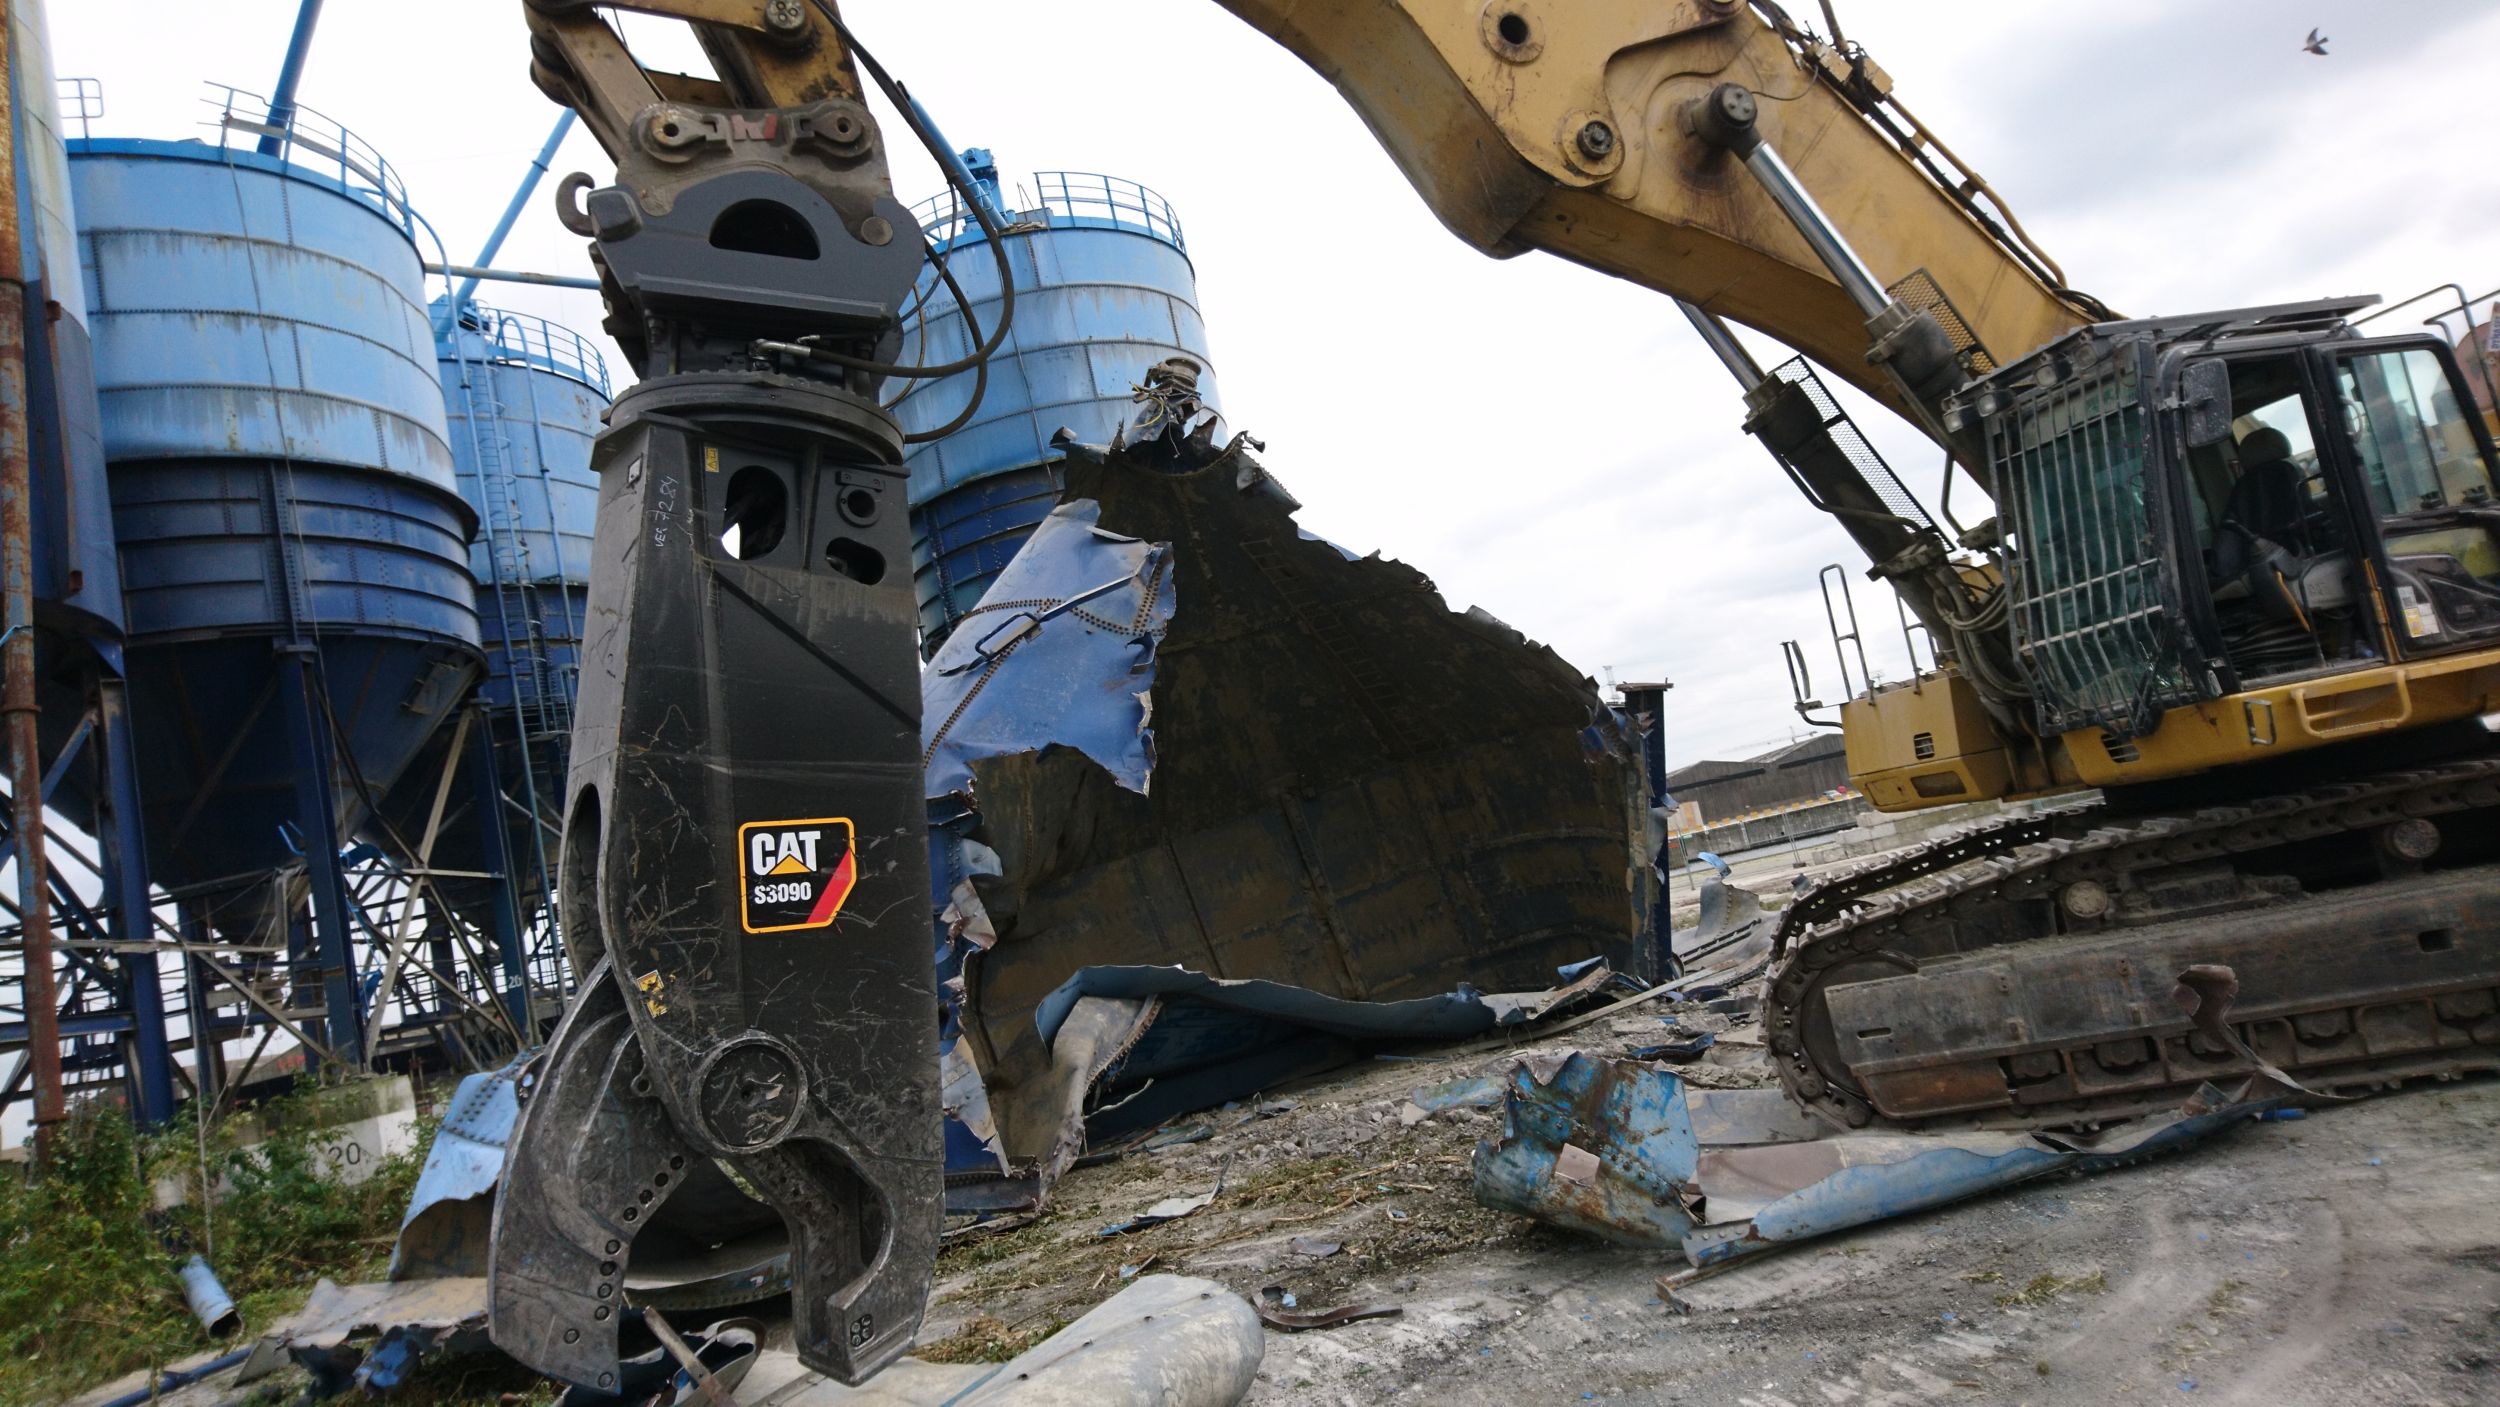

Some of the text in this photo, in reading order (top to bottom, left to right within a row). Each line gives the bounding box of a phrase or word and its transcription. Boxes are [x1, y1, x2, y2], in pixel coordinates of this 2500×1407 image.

[654, 473, 680, 521] 7284
[751, 830, 821, 876] CAT
[754, 881, 812, 904] S3090
